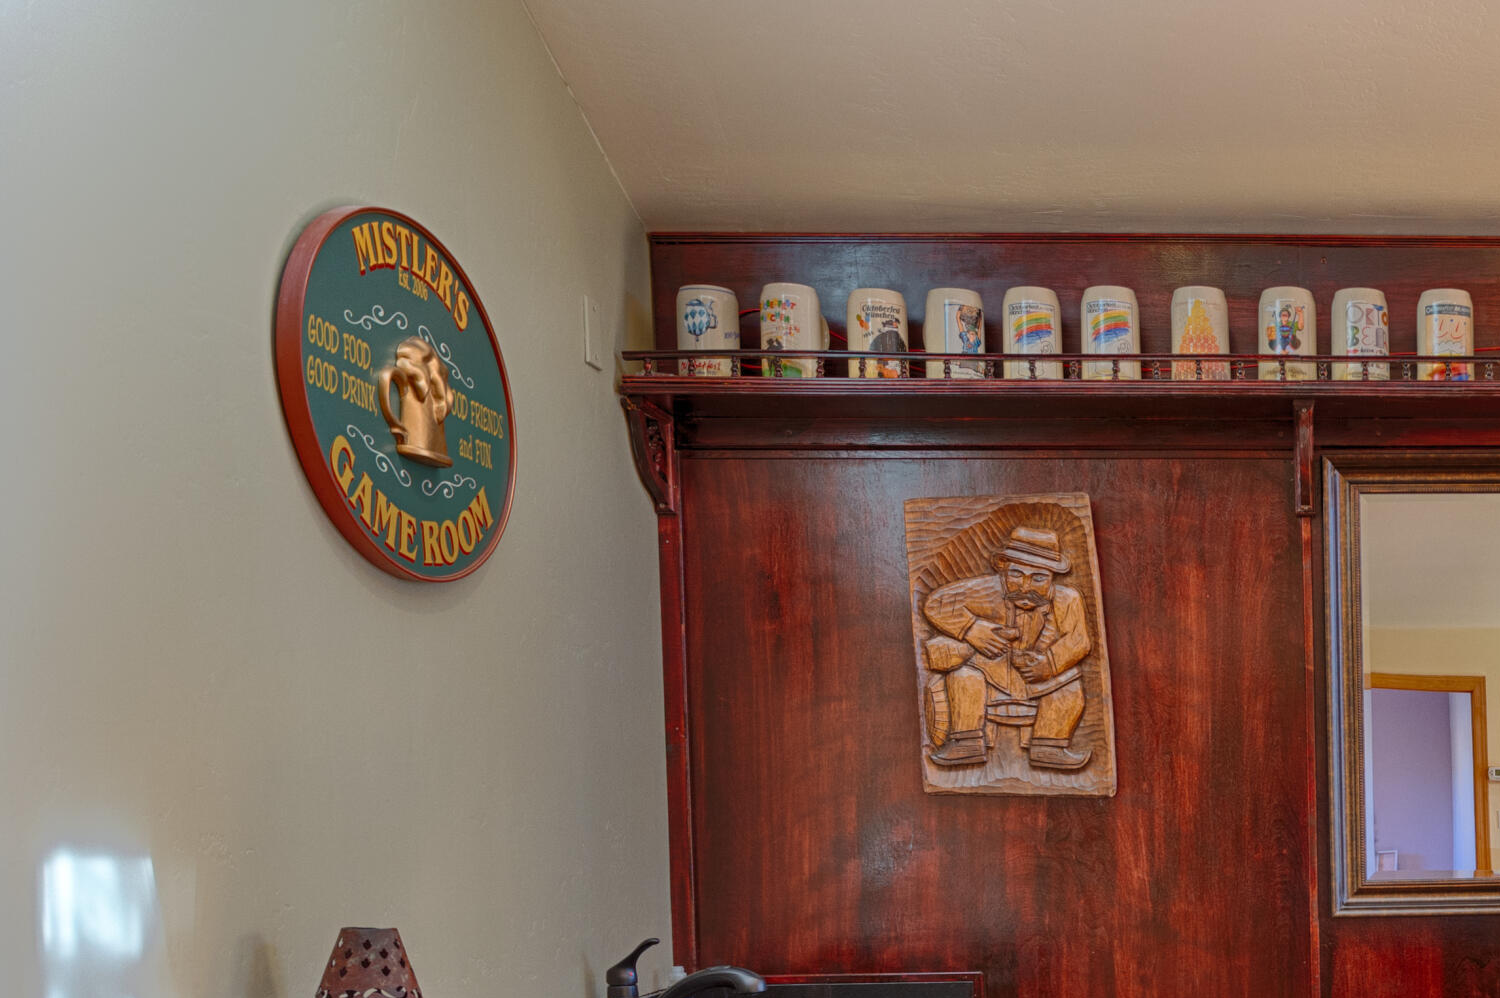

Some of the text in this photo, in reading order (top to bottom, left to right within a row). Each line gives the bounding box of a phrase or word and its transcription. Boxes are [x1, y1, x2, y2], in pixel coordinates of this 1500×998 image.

[352, 221, 470, 332] MISTLER'S
[398, 267, 429, 302] Est. 2006
[307, 314, 375, 377] GOOD FOOD,
[306, 355, 379, 417] GOOD DRINK,
[450, 388, 504, 440] OOD FRIENDS
[458, 437, 494, 471] and FUN.
[329, 435, 495, 567] GAME ROOM
